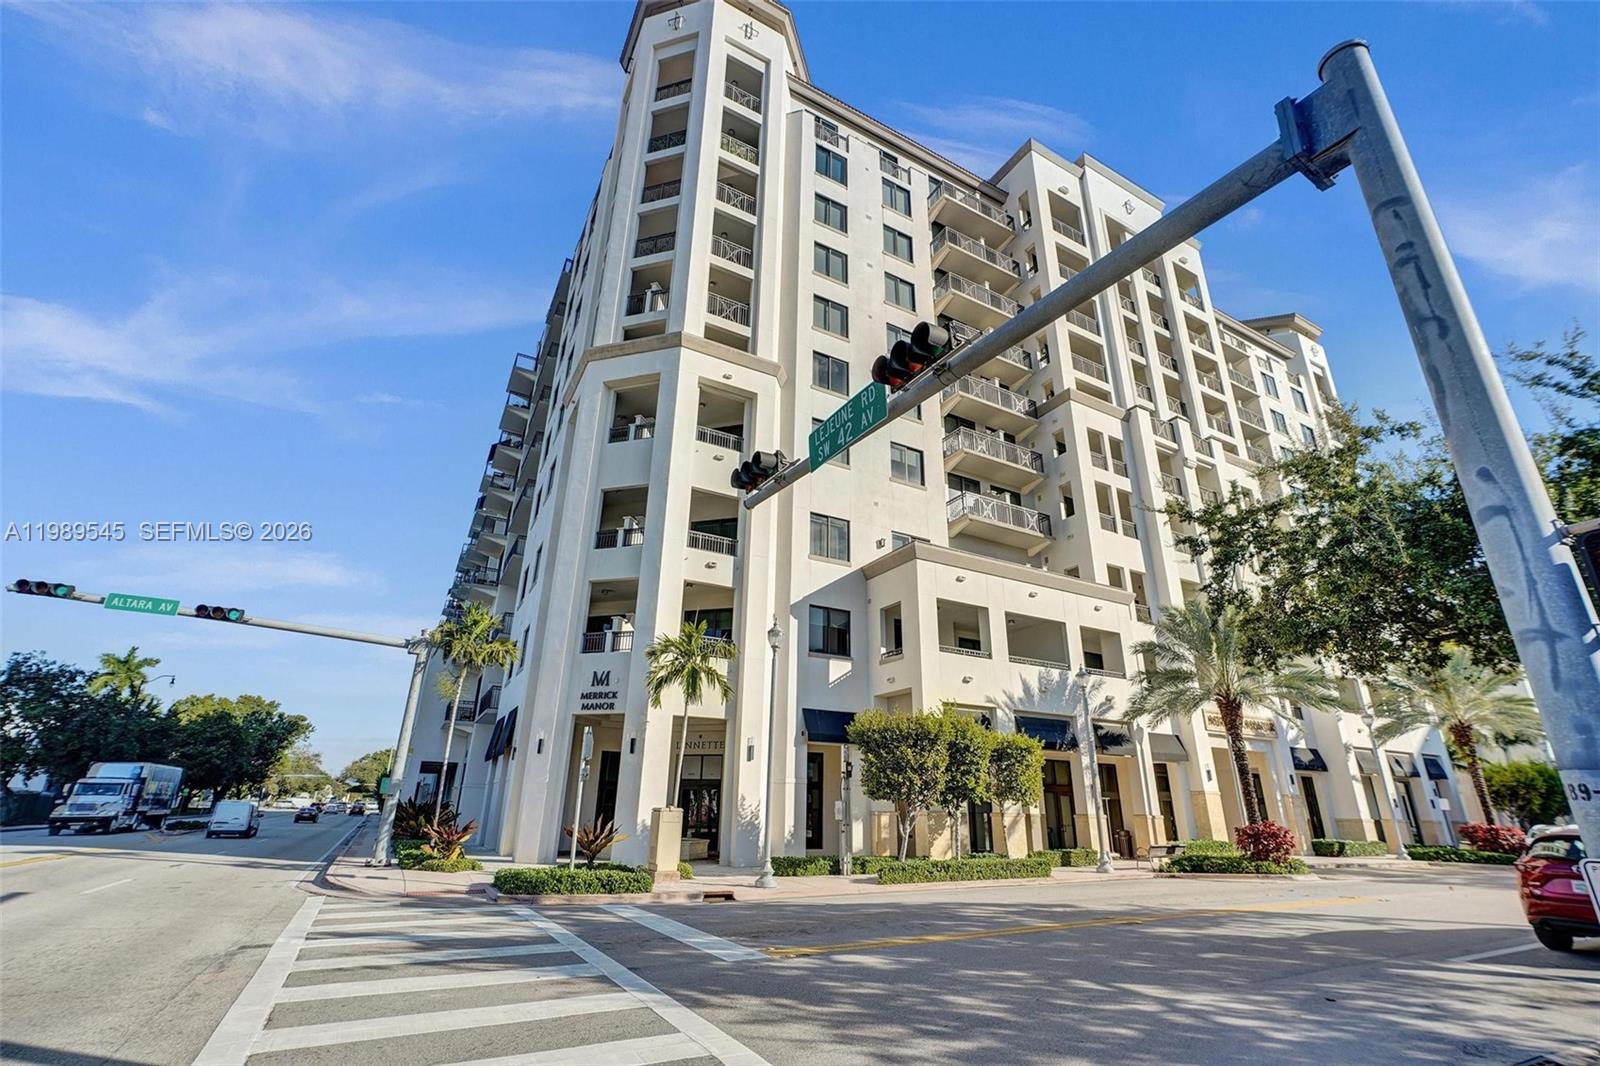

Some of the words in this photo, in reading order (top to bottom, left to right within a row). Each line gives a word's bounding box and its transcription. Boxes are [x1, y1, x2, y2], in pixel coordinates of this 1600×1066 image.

[814, 401, 854, 446] LEJEUNE
[860, 385, 876, 408] RD
[818, 440, 831, 461] SW
[837, 422, 853, 446] 42
[861, 406, 874, 430] AV
[111, 597, 153, 610] ALTARA
[158, 603, 174, 612] AV
[580, 691, 618, 700] MERRICK
[581, 702, 615, 711] MANOR
[676, 741, 726, 750] LNNETTE
